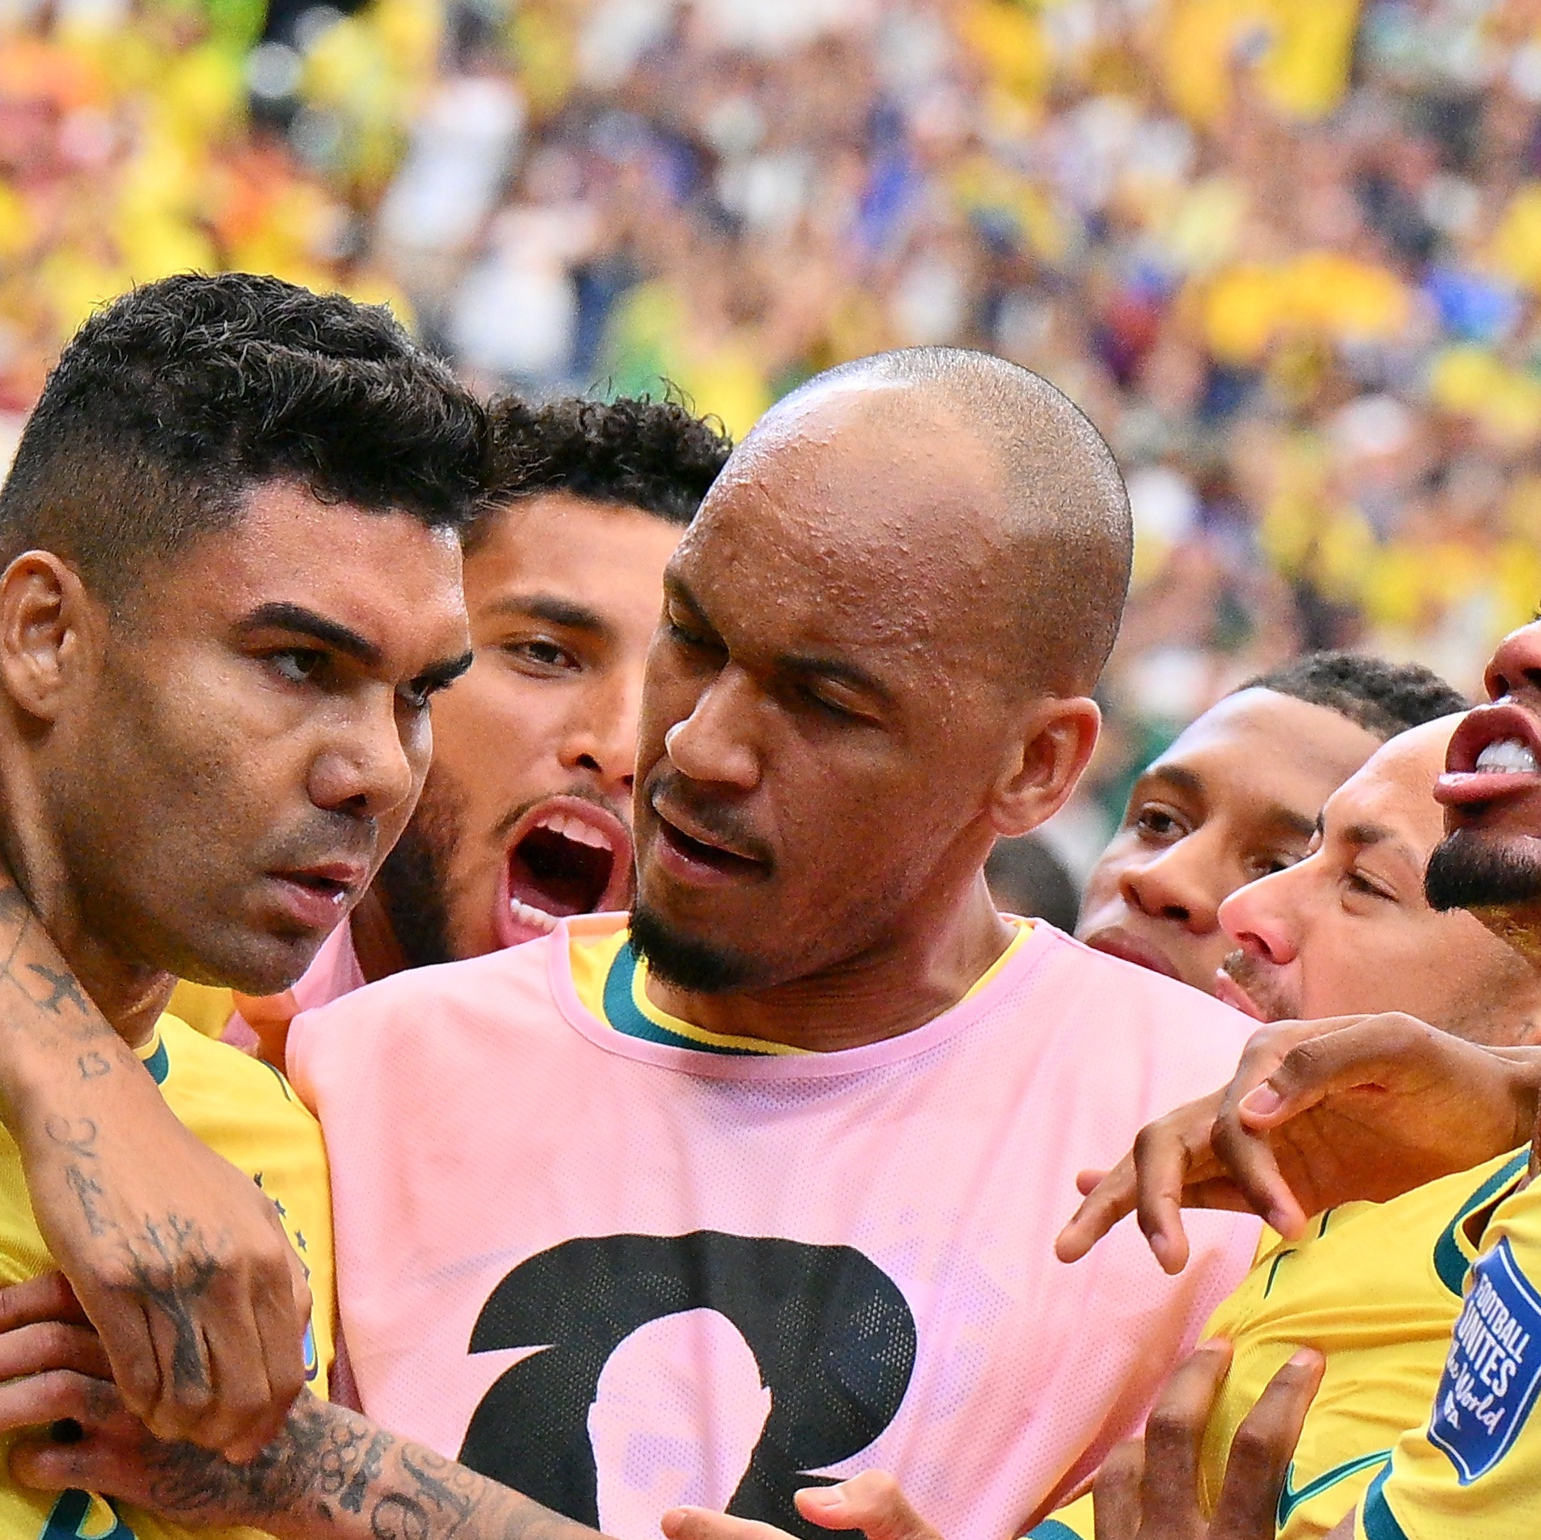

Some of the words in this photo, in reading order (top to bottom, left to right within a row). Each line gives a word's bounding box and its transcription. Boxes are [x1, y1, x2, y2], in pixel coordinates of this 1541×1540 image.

[1458, 1300, 1516, 1397] UNITES
[1475, 1272, 1530, 1364] FOOTBALL
[1455, 1362, 1506, 1436] World
